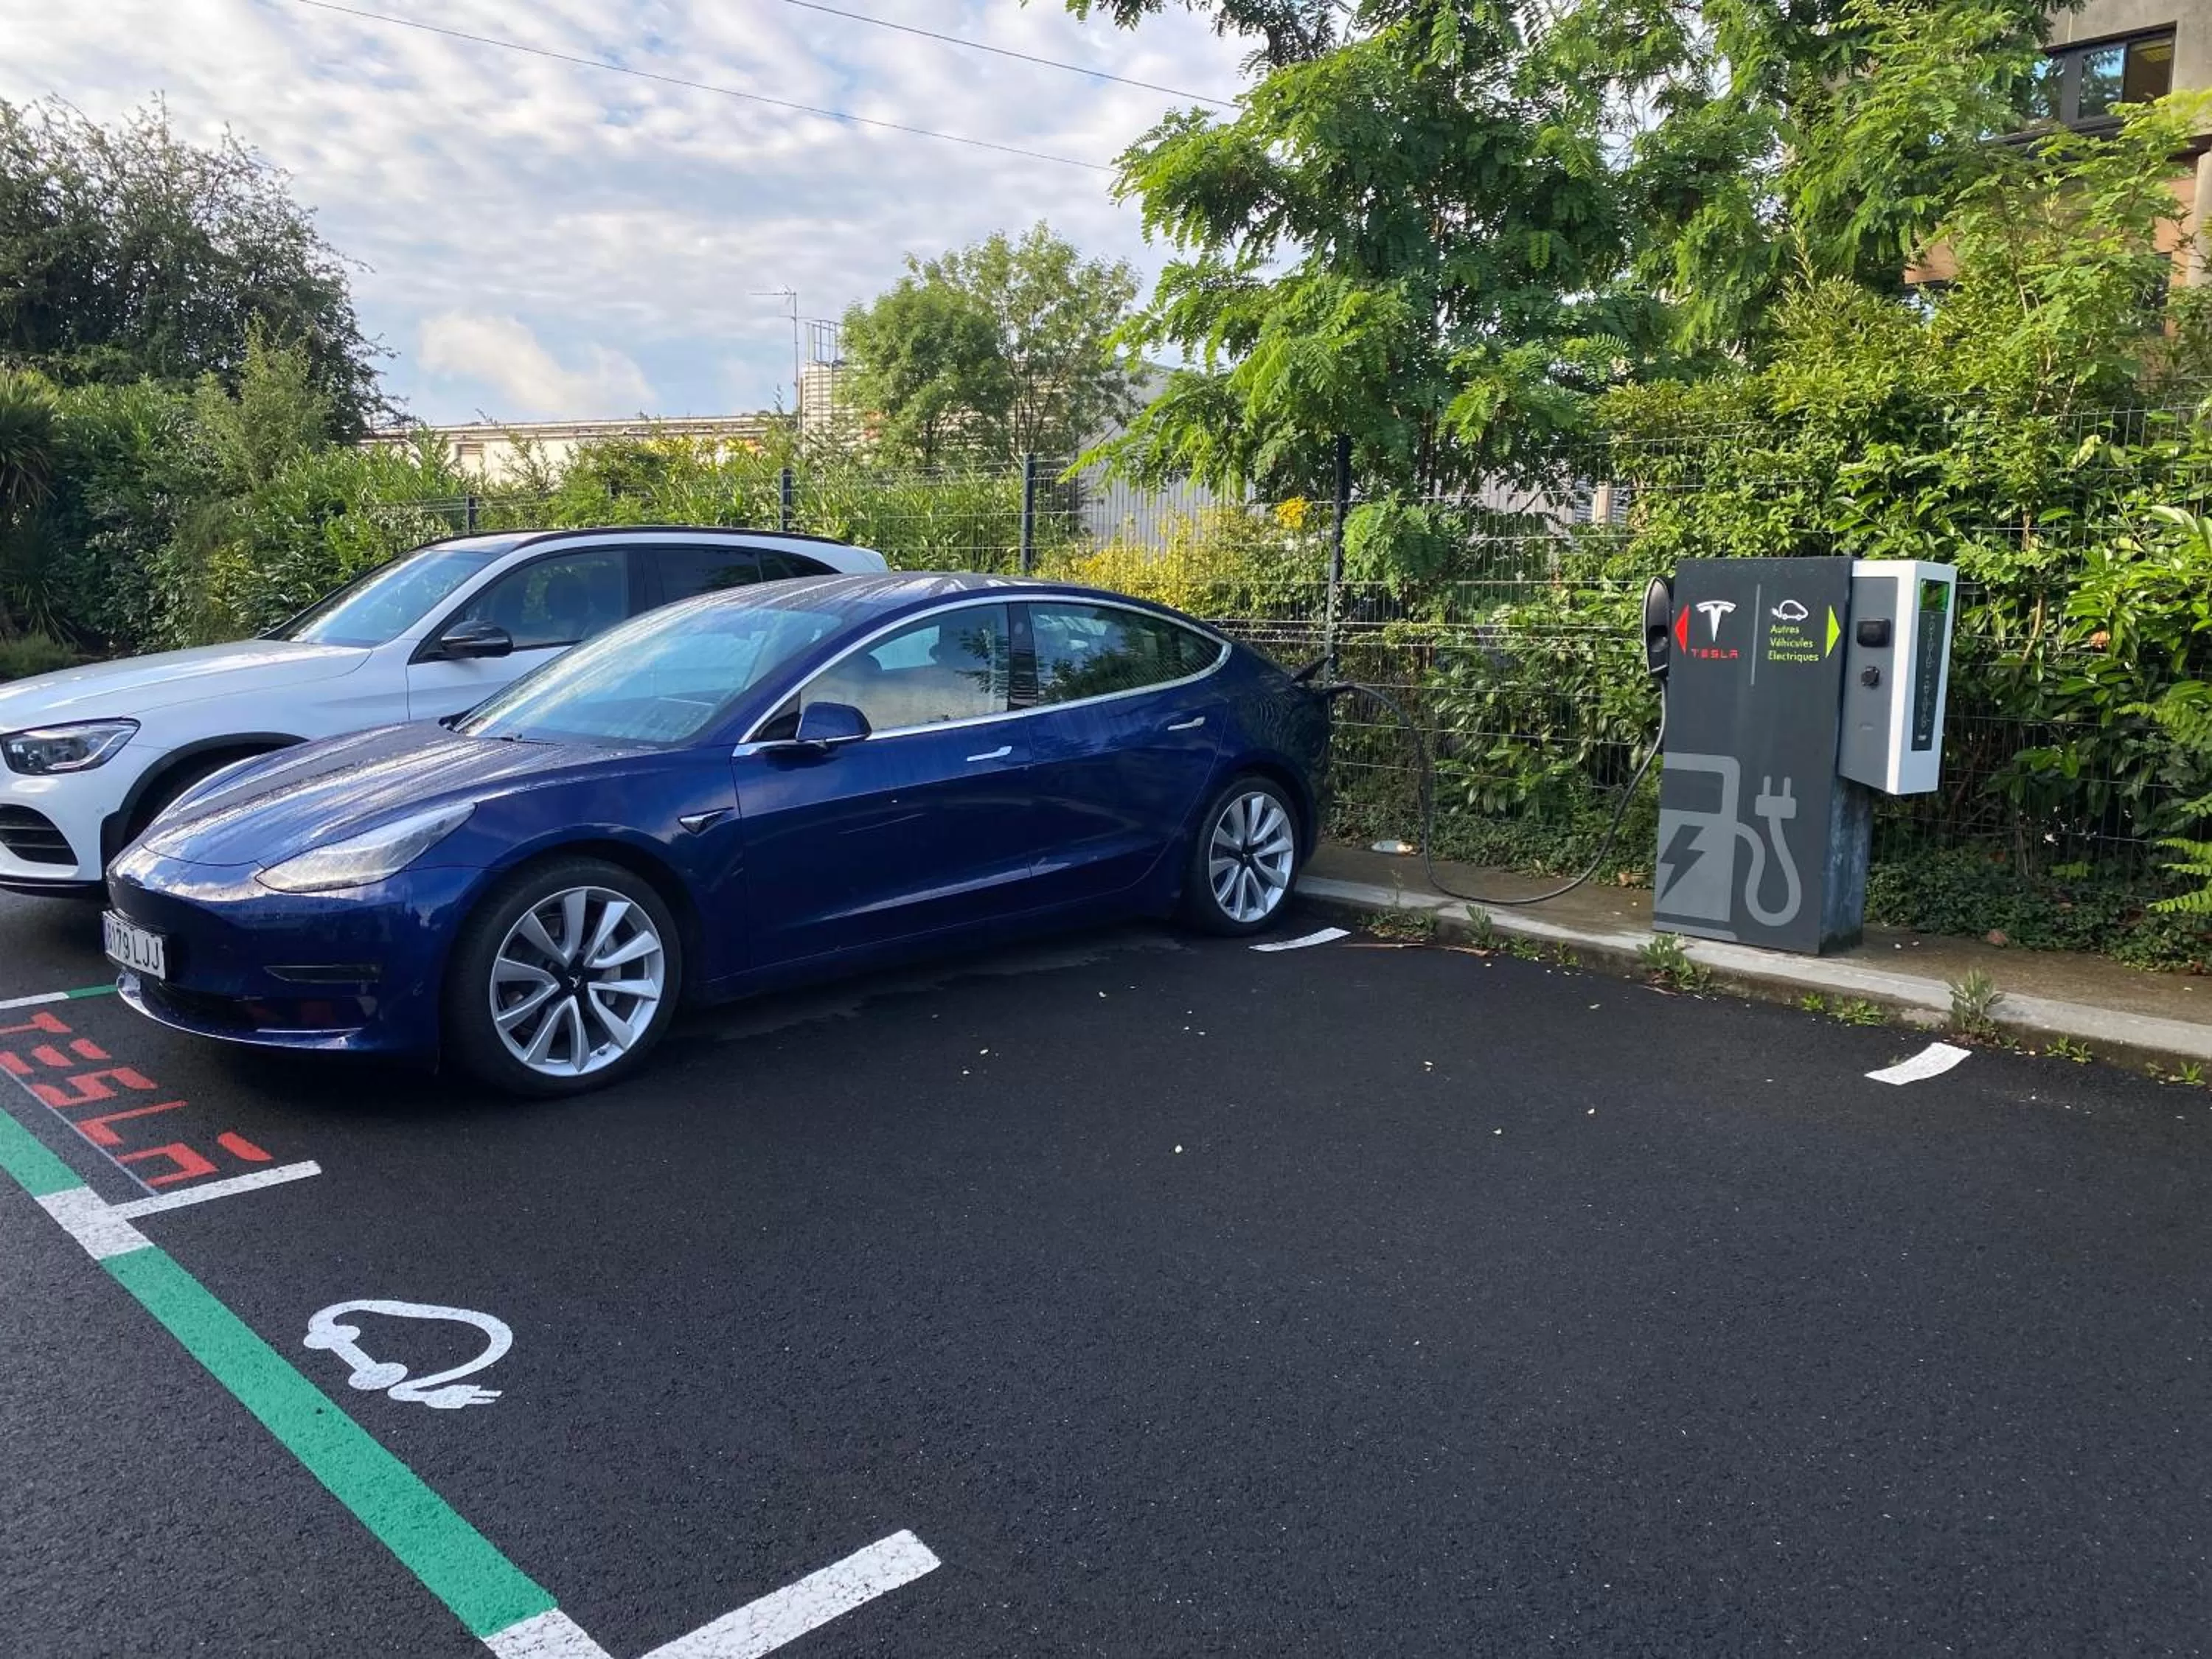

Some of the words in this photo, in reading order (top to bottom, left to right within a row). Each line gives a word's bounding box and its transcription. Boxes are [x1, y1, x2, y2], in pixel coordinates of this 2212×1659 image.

[1770, 625, 1800, 634] Autres
[1770, 636, 1814, 648] Véhicules
[1691, 648, 1739, 658] TESLA
[132, 933, 160, 970] LJJ
[0, 1010, 274, 1188] TESLA
